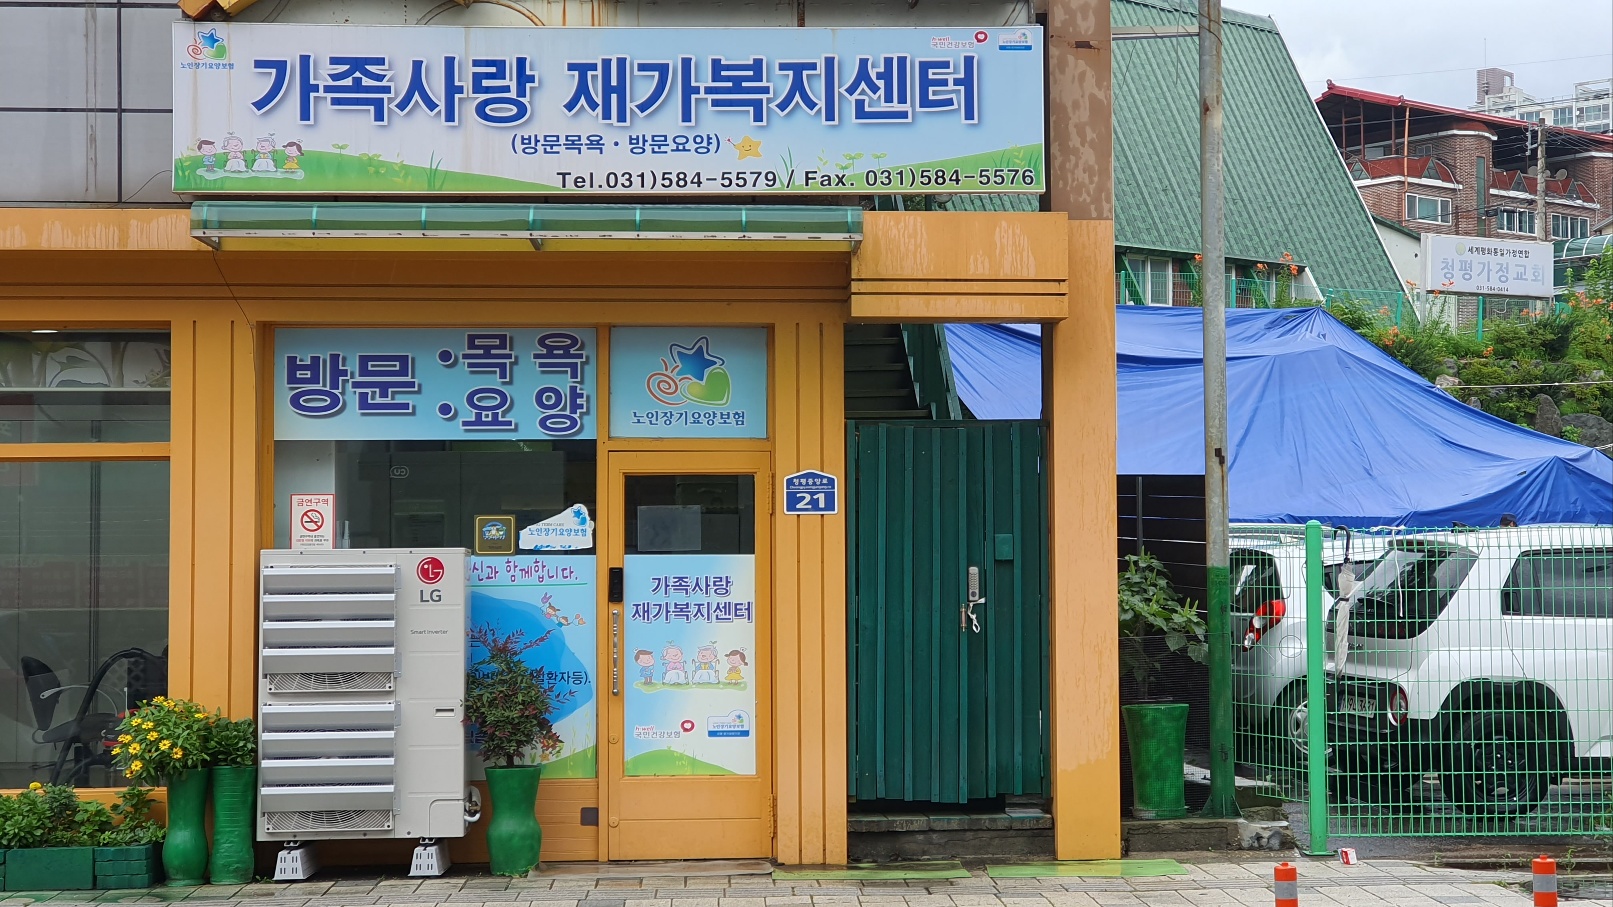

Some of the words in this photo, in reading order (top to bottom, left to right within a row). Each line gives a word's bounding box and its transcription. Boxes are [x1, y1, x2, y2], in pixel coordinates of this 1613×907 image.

[251, 53, 537, 126] 가족사랑
[563, 53, 979, 126] 재가복지센터
[511, 134, 605, 155] (방문목욕
[628, 134, 721, 155] 방문요양)
[557, 169, 777, 190] Tel.031)584-5579
[804, 170, 856, 188] Fax.
[865, 168, 1035, 189] 031)584-5576
[1468, 246, 1530, 259] 세계평화통일가정연합
[1440, 257, 1545, 286] 청평가정교회
[285, 351, 419, 417] 방문
[631, 410, 746, 428] 노인장기요양보험
[296, 498, 329, 507] 금연구역
[796, 492, 825, 508] 21
[528, 528, 588, 538] 노인장기요양보험
[504, 558, 578, 583] 함께합니다.
[420, 588, 442, 603] LG
[650, 575, 734, 598] 가족사랑
[630, 601, 753, 624] 재가복지센터
